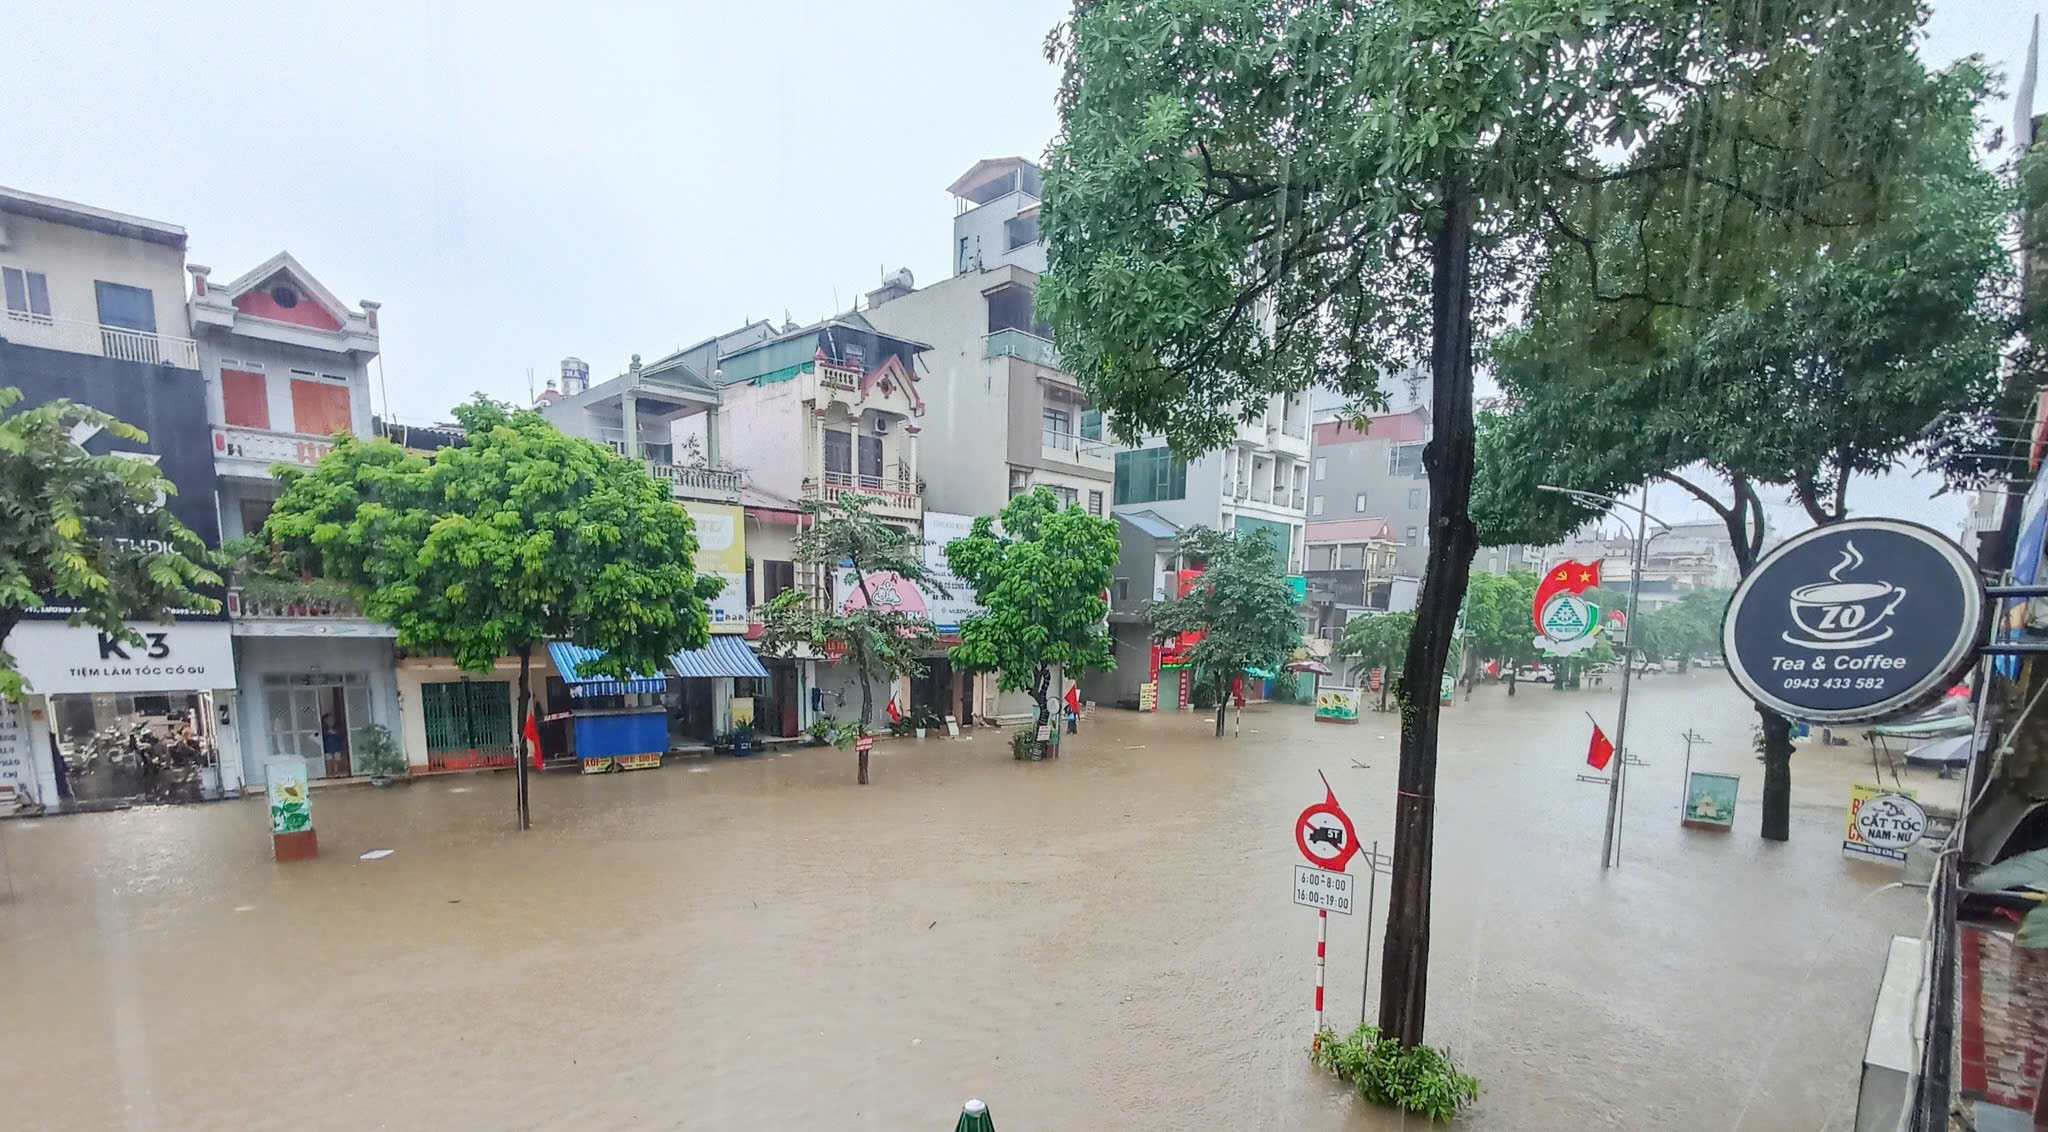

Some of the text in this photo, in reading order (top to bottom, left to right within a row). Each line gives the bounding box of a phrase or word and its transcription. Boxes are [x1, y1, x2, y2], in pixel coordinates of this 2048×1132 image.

[1771, 654, 1907, 671] Tea & Coffee
[104, 666, 132, 677] LÀM
[135, 665, 162, 676] TÓC
[165, 664, 185, 675] CÓ
[1783, 677, 1885, 690] 0943 433 582
[1861, 813, 1922, 832] CẮT TÓC
[1327, 829, 1340, 839] 5T
